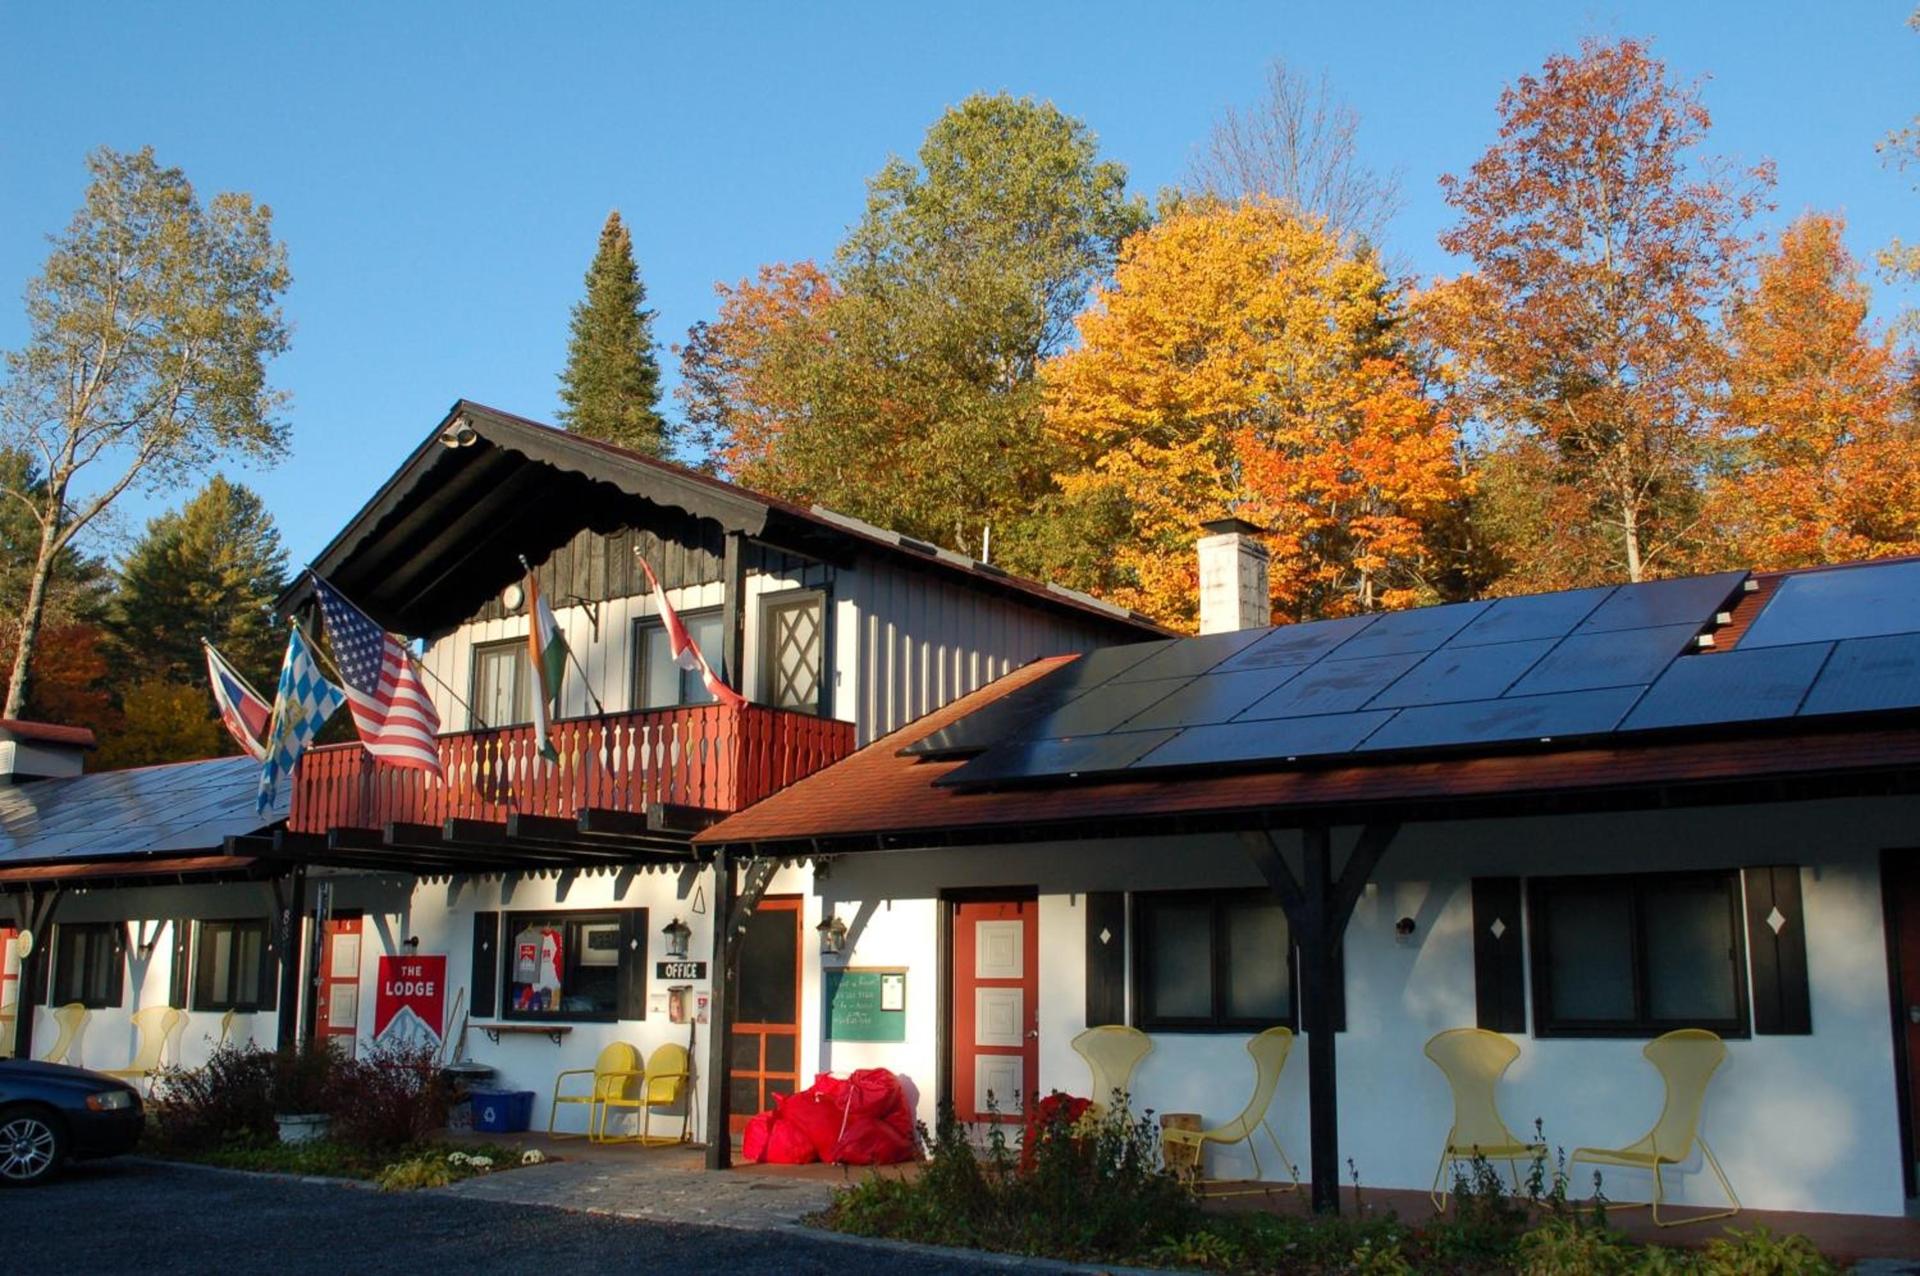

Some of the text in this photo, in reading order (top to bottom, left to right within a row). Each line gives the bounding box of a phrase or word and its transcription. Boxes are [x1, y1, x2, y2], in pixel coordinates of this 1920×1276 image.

[401, 966, 422, 977] THE
[665, 963, 697, 978] OFFICE
[385, 981, 434, 996] LODGE
